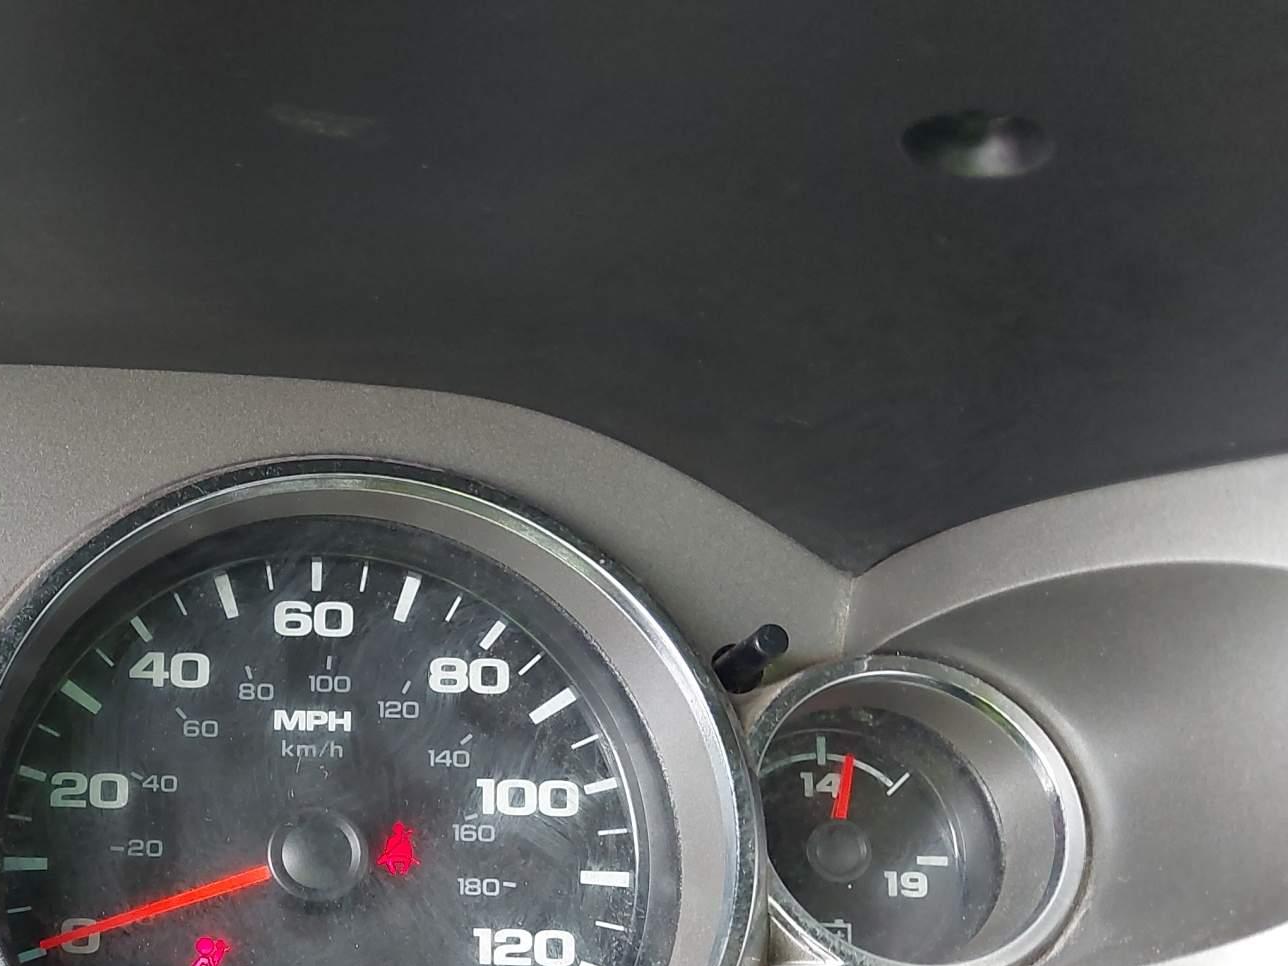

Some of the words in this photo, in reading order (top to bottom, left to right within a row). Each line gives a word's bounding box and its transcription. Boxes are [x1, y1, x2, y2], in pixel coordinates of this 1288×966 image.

[273, 602, 353, 637] 60
[129, 652, 210, 687] 40
[428, 658, 510, 694] 80
[238, 682, 274, 701] 80
[308, 675, 351, 693] 100
[378, 701, 420, 719] 120
[184, 720, 219, 738] 60
[273, 709, 352, 732] MPH
[281, 738, 344, 758] km/h
[428, 750, 470, 768] 140
[50, 773, 129, 808] 20
[142, 774, 178, 793] 40
[800, 772, 841, 798] 14
[476, 778, 579, 817] 100
[453, 824, 496, 843] 160
[127, 839, 163, 857] 20
[457, 877, 500, 896] 180
[884, 870, 929, 899] 19
[60, 917, 101, 954] 0
